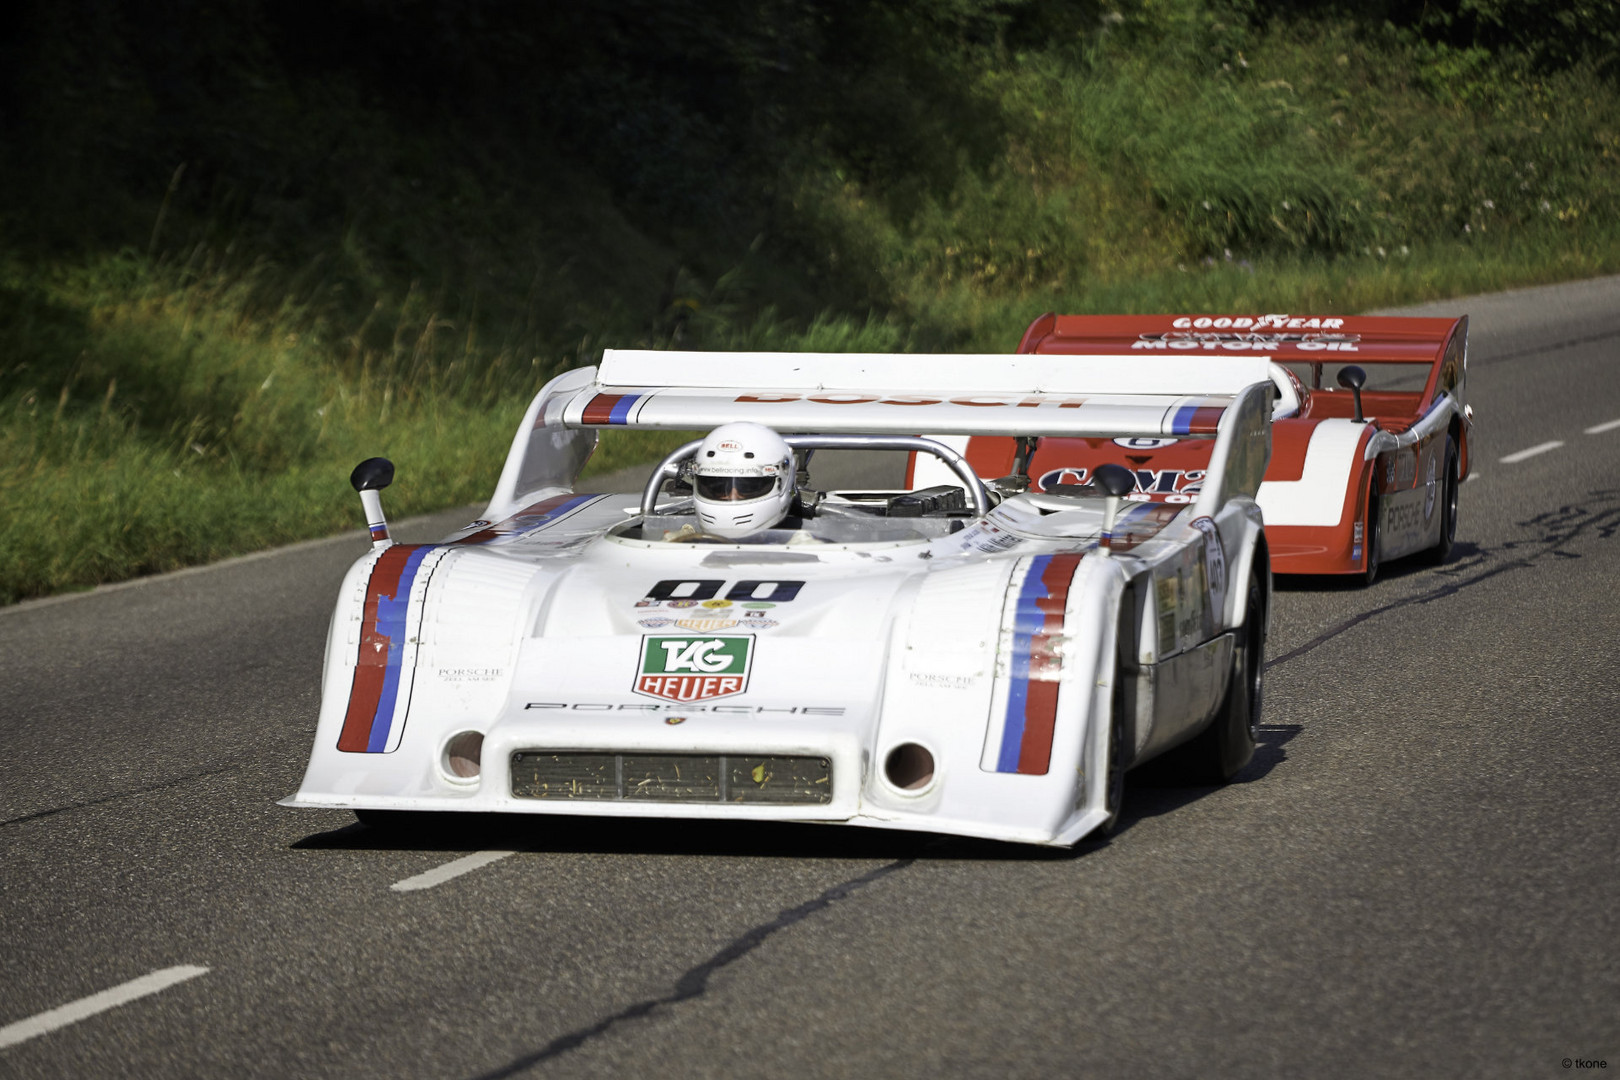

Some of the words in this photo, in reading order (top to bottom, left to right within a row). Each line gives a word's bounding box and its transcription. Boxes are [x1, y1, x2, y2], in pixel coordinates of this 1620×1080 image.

[1172, 314, 1344, 331] GOODYEAR
[1131, 340, 1281, 351] MOTOR
[1296, 341, 1359, 352] OIL
[733, 392, 1090, 409] BOSCH
[1038, 467, 1208, 495] CM2
[645, 580, 806, 602] 00
[661, 638, 734, 673] TAG
[439, 668, 504, 676] PORSCHE
[909, 673, 976, 684] PORSCHE
[640, 676, 738, 702] HEUER
[524, 701, 846, 717] PORSCHE
